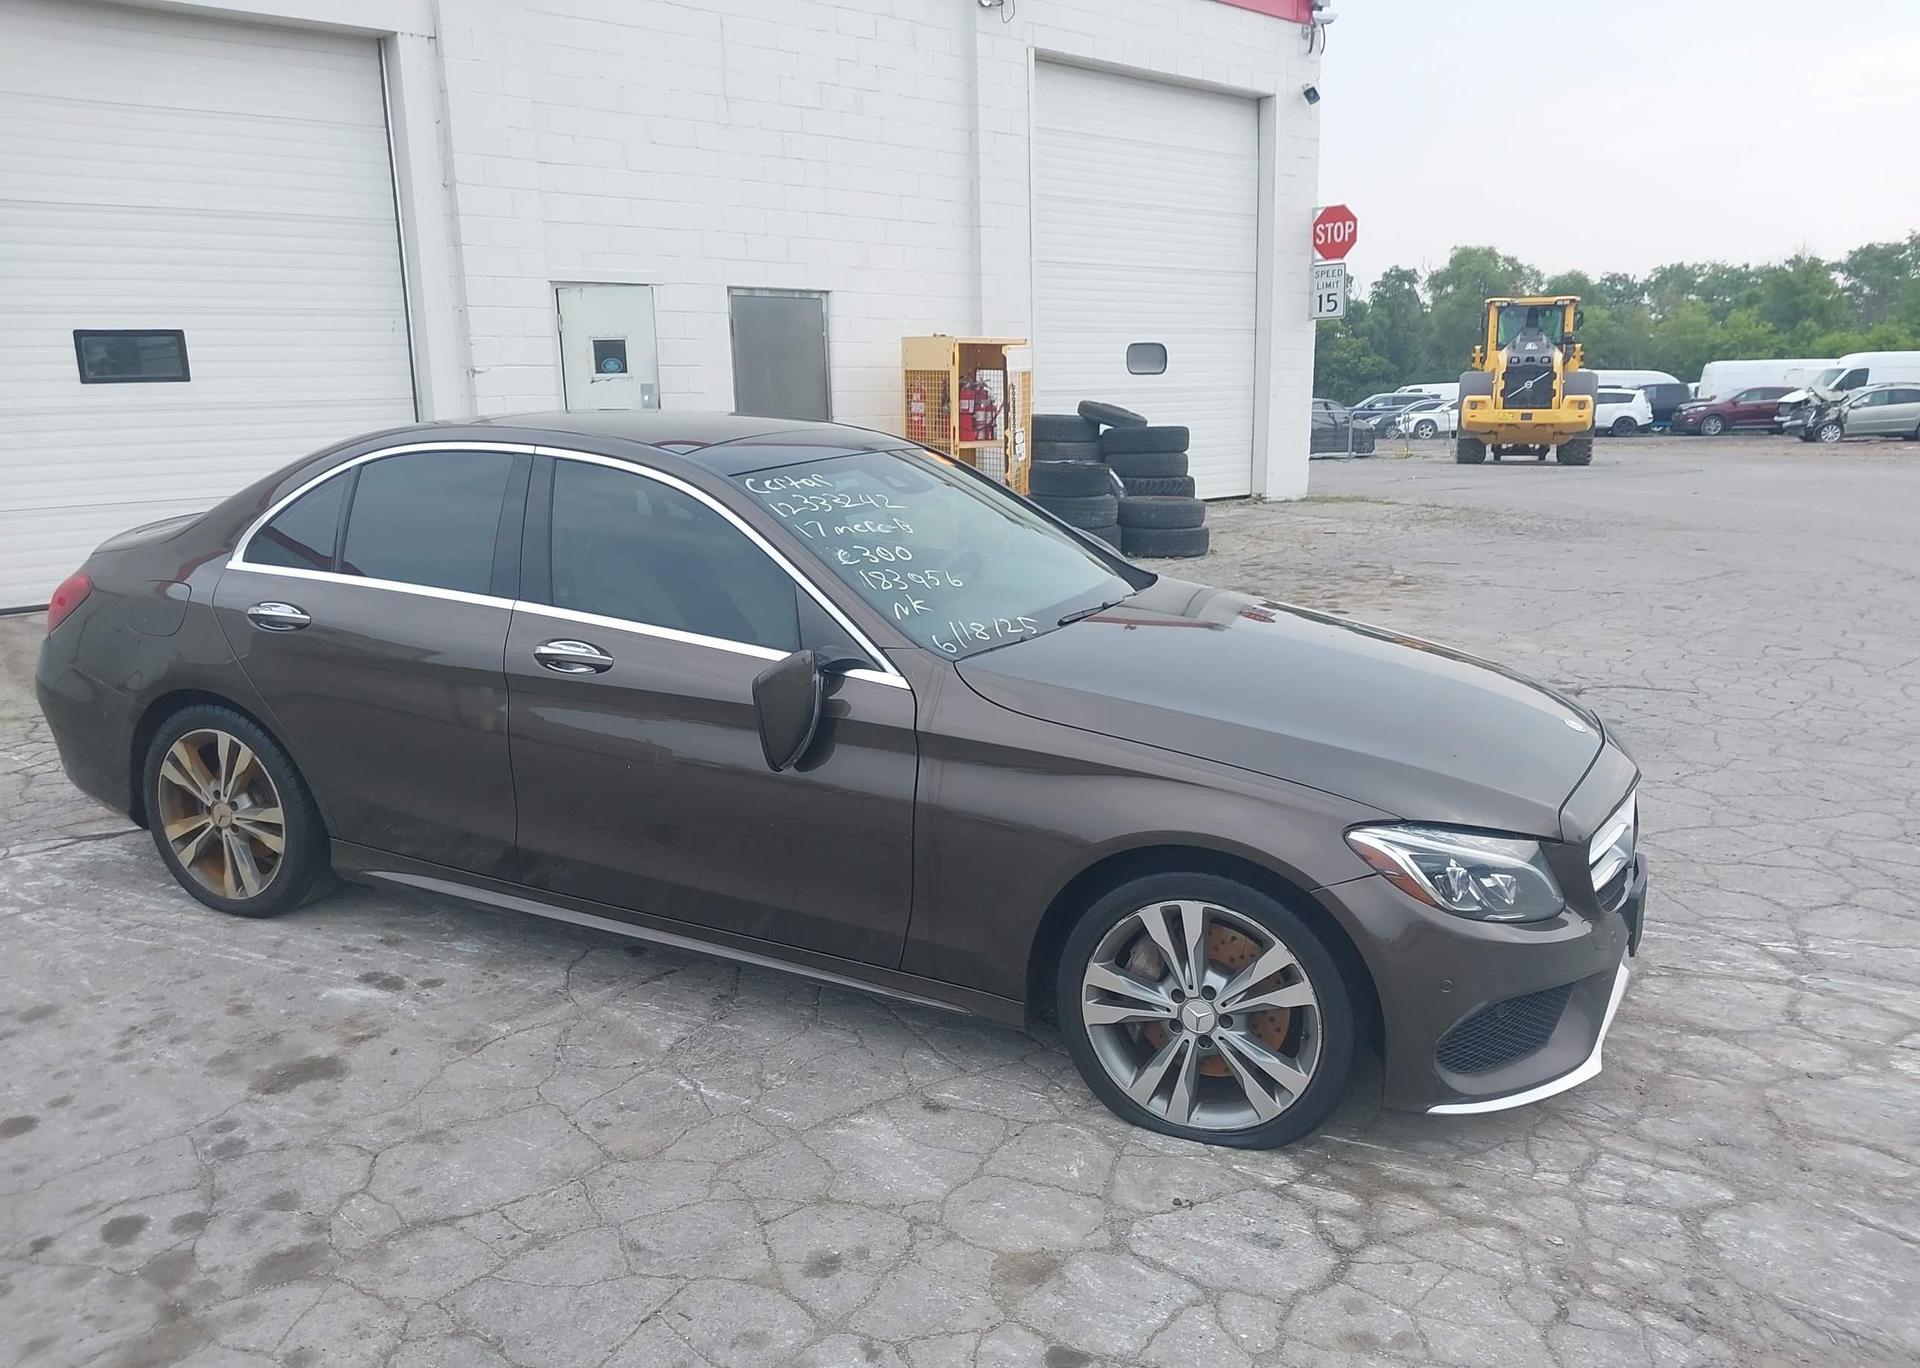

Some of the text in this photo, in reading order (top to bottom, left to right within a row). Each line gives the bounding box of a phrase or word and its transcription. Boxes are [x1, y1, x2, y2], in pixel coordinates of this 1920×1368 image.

[1316, 221, 1354, 244] STOP
[1315, 269, 1343, 279] SPEED
[1317, 281, 1339, 290] LIMIT
[1317, 293, 1338, 313] 15
[794, 520, 826, 539] 17
[859, 569, 964, 590] 183956
